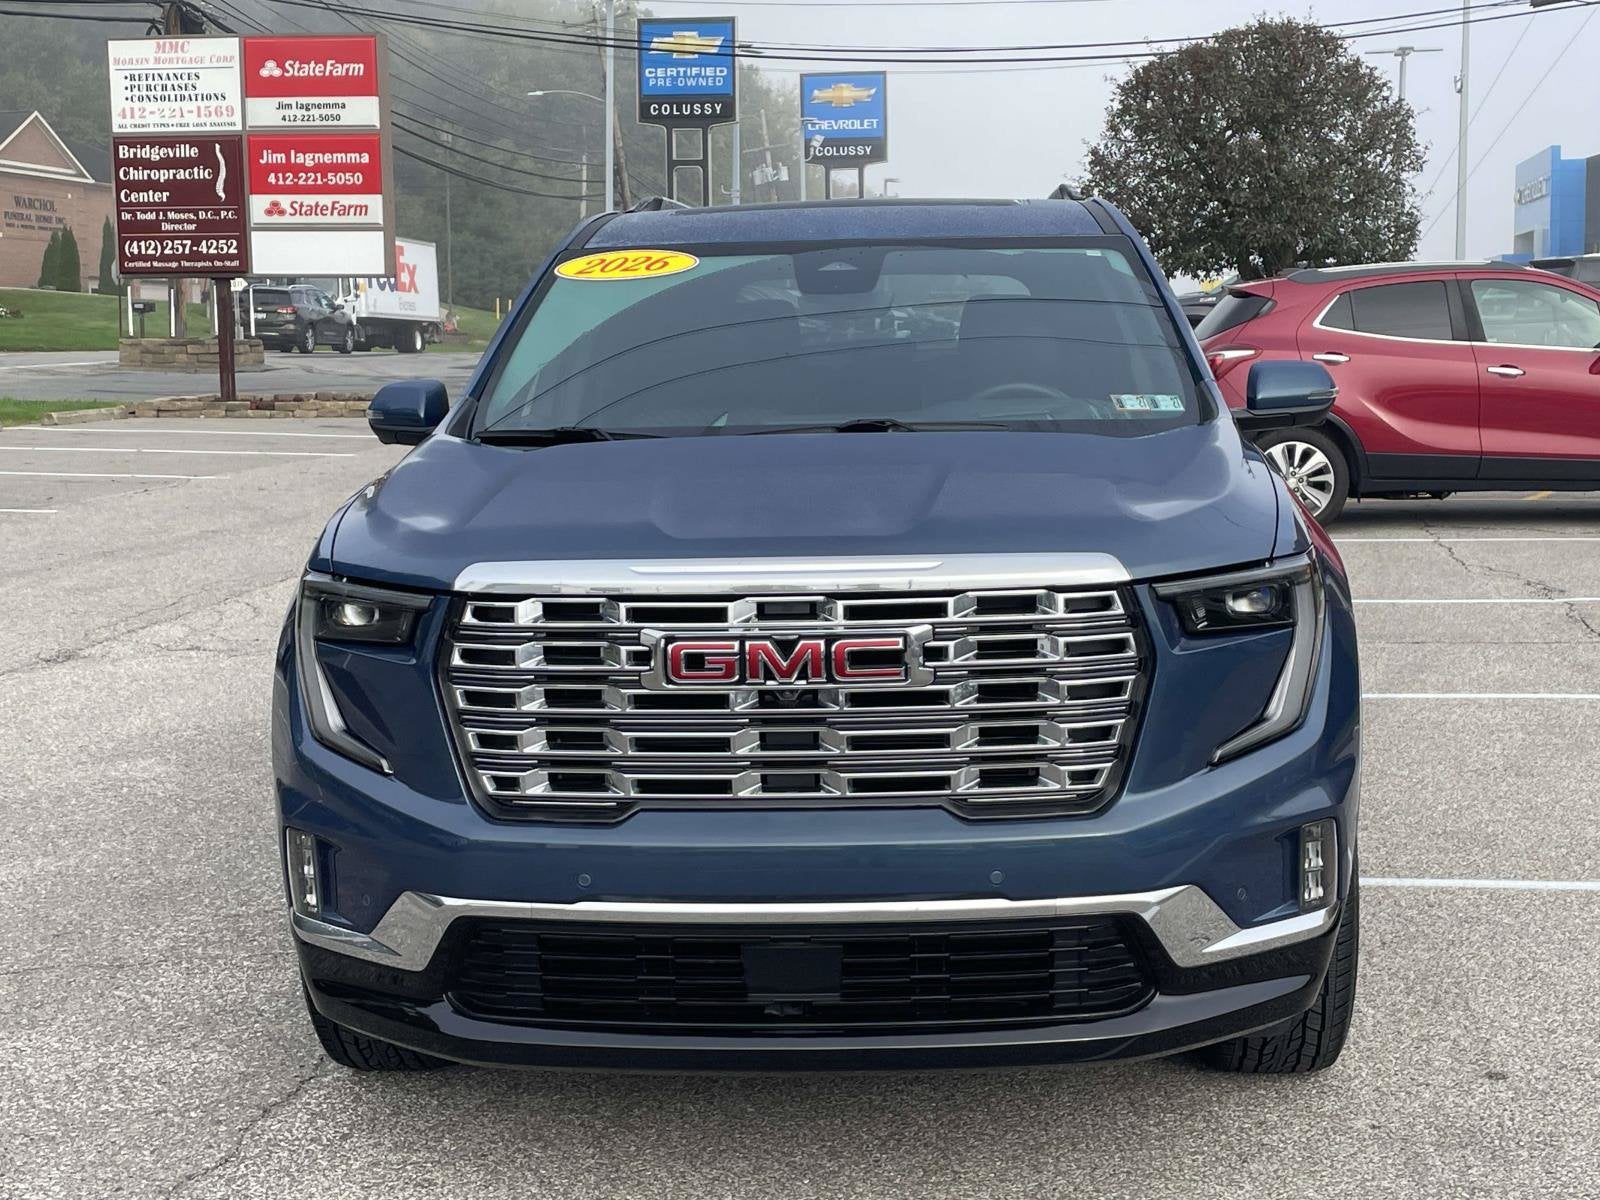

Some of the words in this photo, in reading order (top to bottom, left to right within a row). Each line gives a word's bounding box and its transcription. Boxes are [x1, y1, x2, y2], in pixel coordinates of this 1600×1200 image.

[154, 41, 190, 54] MMC
[154, 55, 207, 65] MORTGAGE
[129, 72, 200, 82] REFINANCES
[645, 66, 728, 78] CERTIFIED
[130, 83, 197, 93] PURCHASES
[649, 77, 724, 87] PRE-OWNED
[130, 93, 226, 103] CONSOLIDATIONS
[275, 101, 293, 110] Jim
[295, 101, 346, 111] Iagnemma
[650, 103, 722, 115] COLUSSY
[118, 105, 235, 120] 412-221-1569
[281, 114, 341, 122] 412-221-5050
[118, 144, 199, 161] Bridgeville
[815, 145, 872, 157] COLUSSY
[259, 149, 286, 164] Jim
[290, 149, 370, 167] Iagnemma
[119, 166, 213, 183] Chiropractic
[267, 172, 363, 185] 412-221-5050
[120, 189, 170, 203] Center
[14, 195, 57, 212] WARCHOL
[121, 212, 134, 220] Dr.
[136, 211, 156, 220] Todd
[158, 211, 166, 220] J.
[167, 211, 197, 220] Moses,
[220, 210, 238, 219] P.C.
[161, 222, 197, 231] Director
[124, 260, 151, 268] Certified
[152, 260, 179, 268] Massage
[180, 260, 212, 268] Therapists
[574, 255, 679, 275] 2026
[669, 638, 906, 684] GMC
